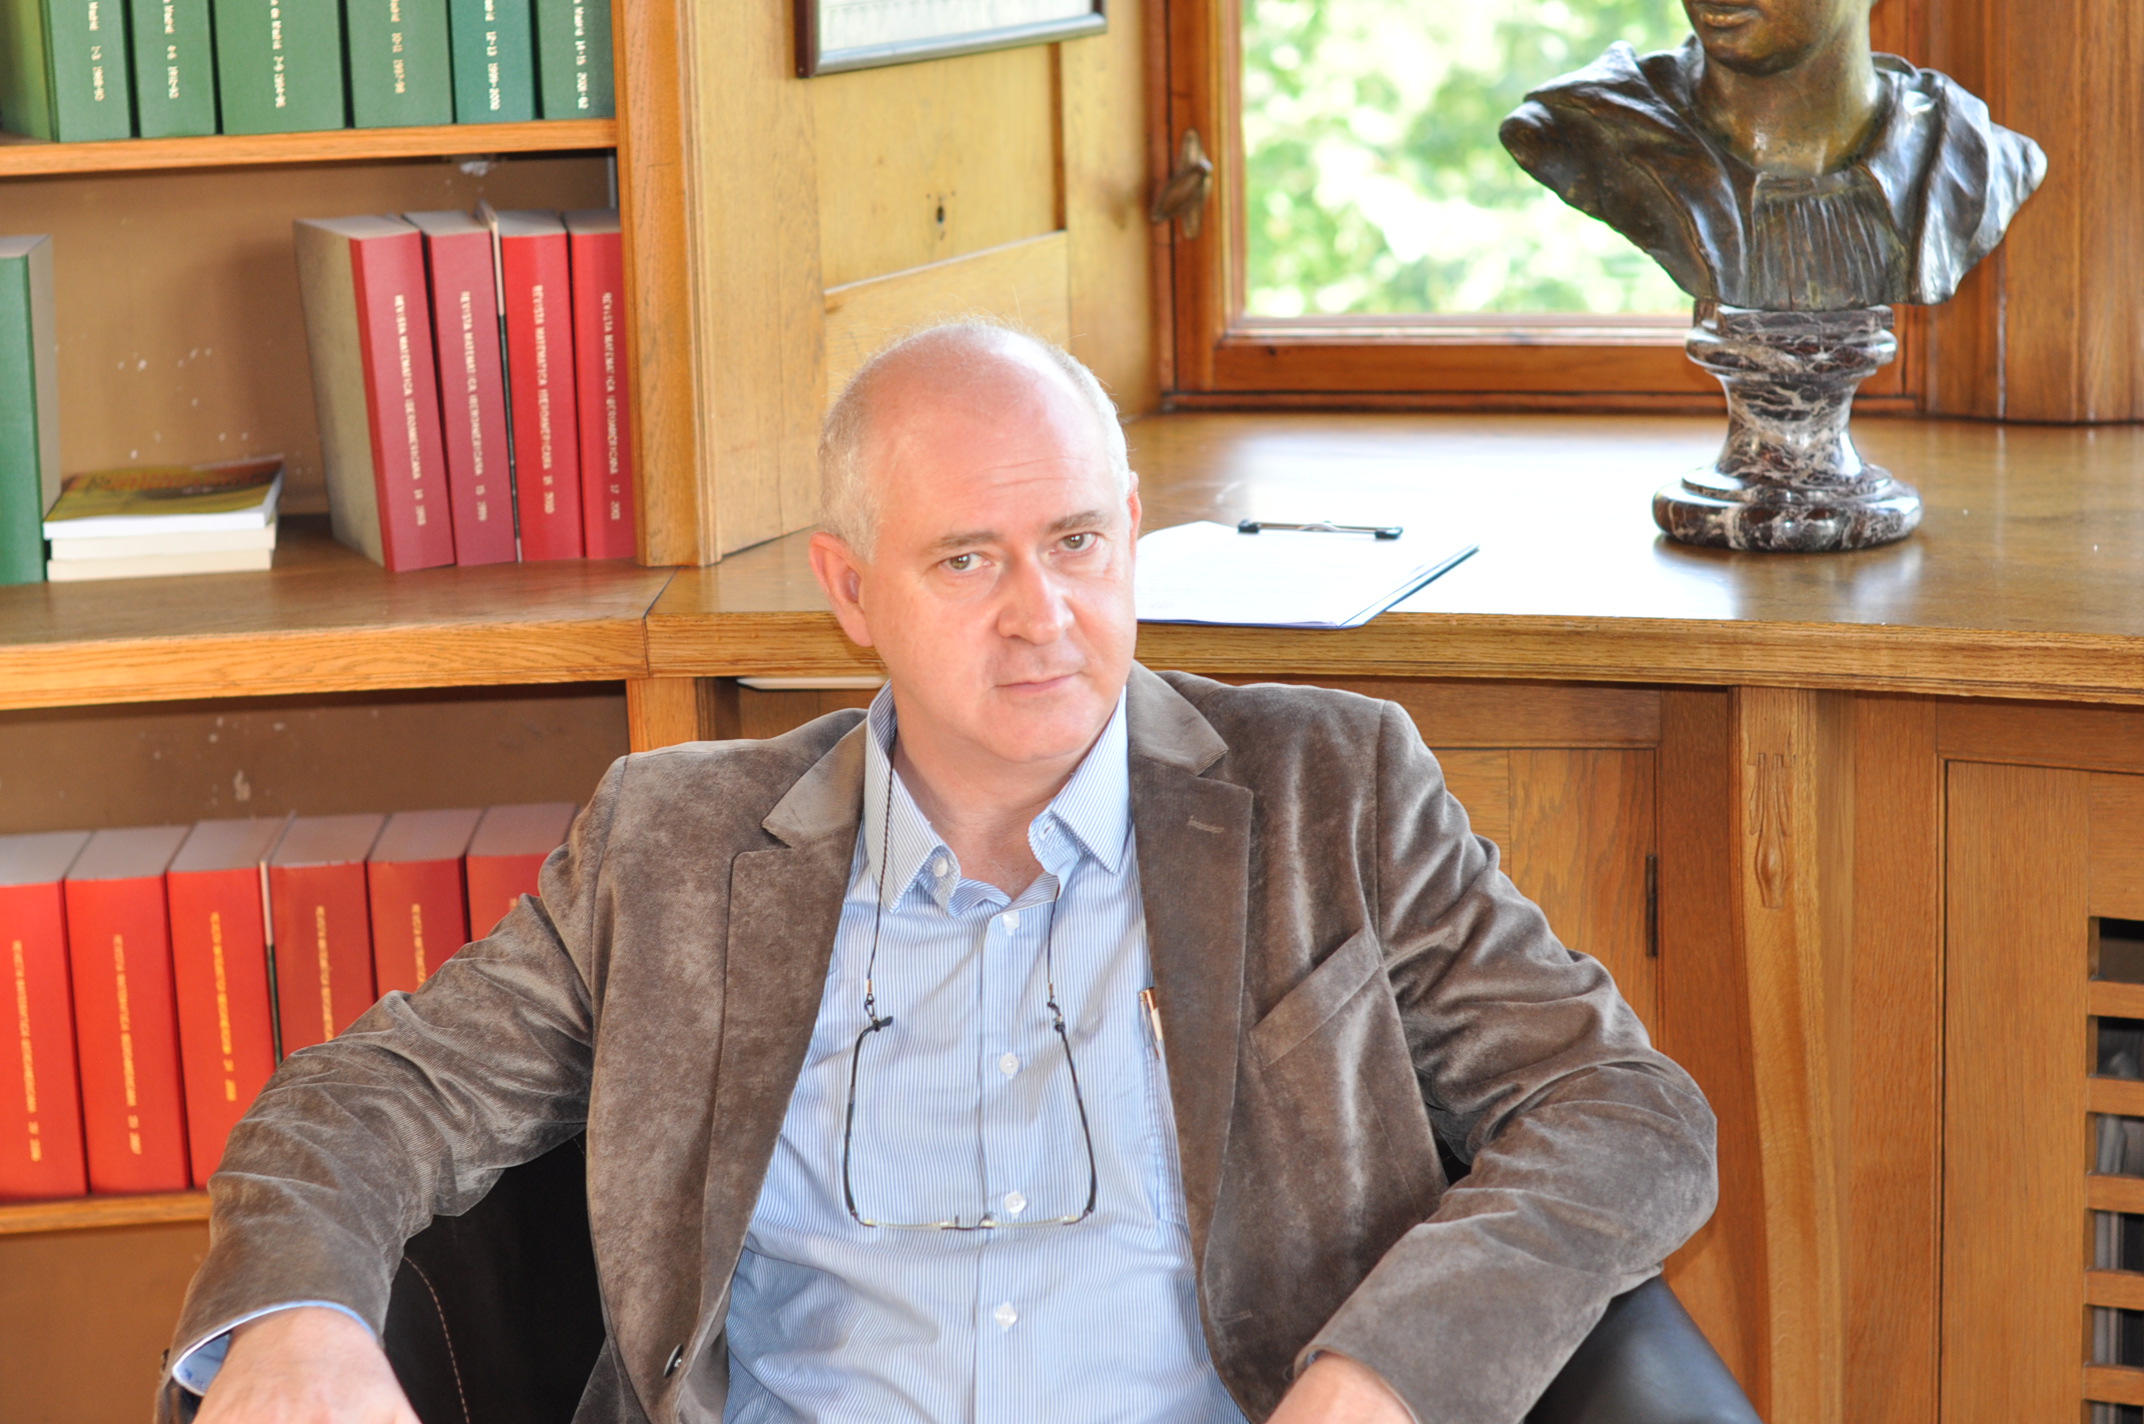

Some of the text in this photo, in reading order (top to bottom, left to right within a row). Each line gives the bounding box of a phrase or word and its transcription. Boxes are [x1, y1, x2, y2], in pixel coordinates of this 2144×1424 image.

[485, 30, 498, 57] 12-13
[393, 294, 407, 336] REVISTA
[459, 290, 473, 331] REVISTA
[532, 284, 545, 325] REVISTA
[601, 292, 613, 333] REVISTA
[398, 335, 413, 396] MATEMATICA
[463, 331, 477, 392] MATEMATICA
[535, 326, 548, 386] MATEMATICA
[603, 334, 615, 392] MATEMATICA
